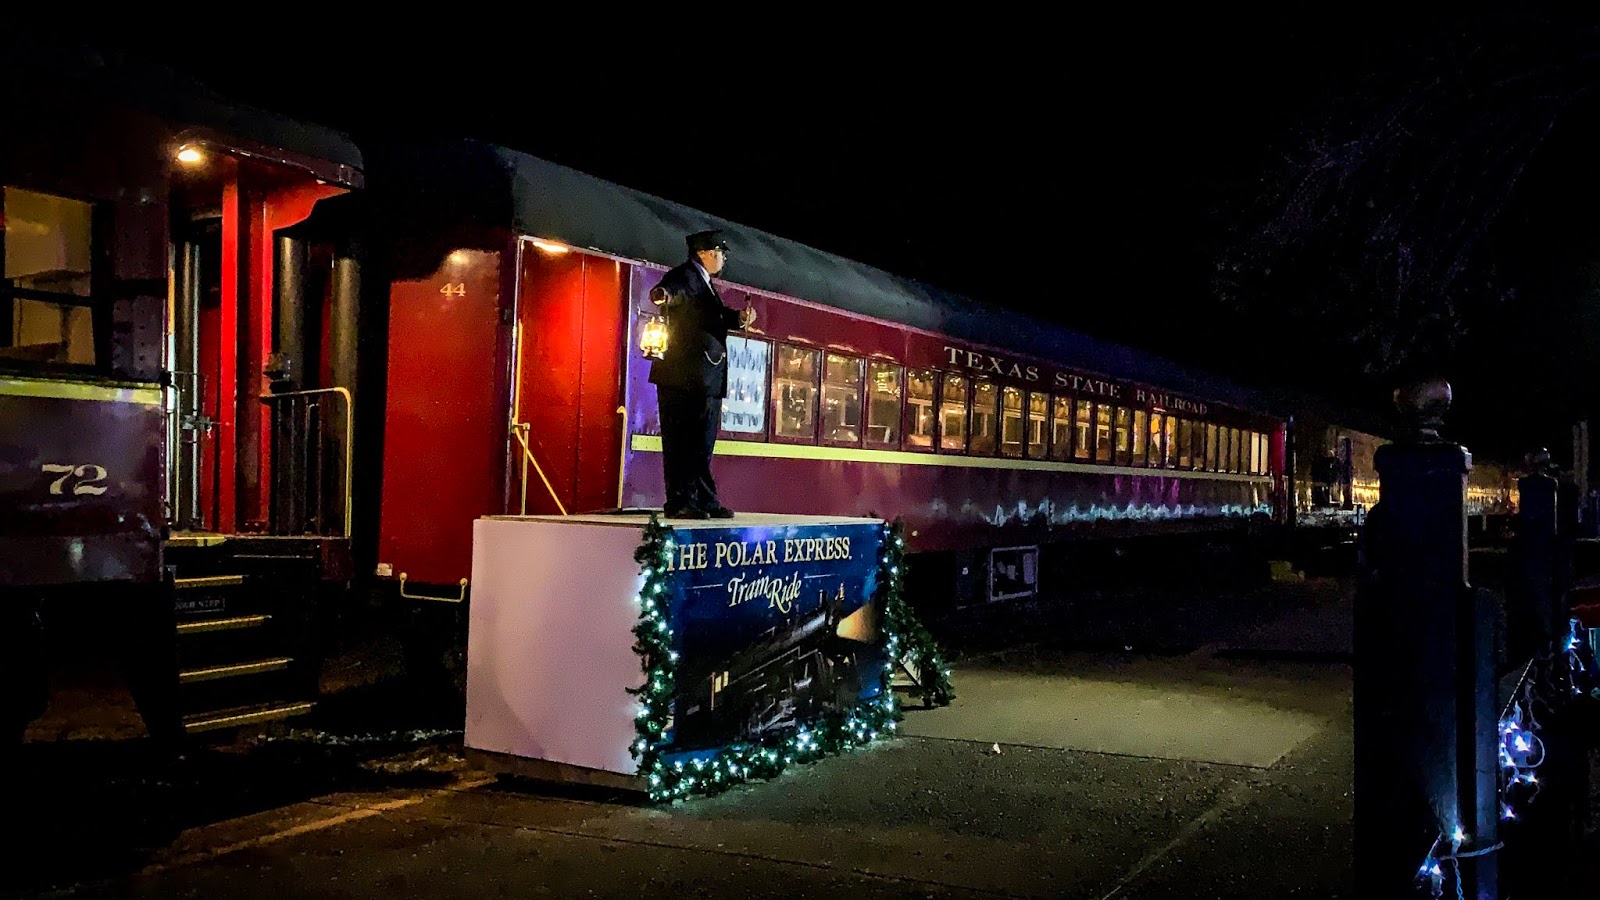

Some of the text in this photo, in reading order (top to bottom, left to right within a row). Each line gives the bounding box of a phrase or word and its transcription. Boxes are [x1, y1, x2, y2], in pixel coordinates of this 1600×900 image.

[439, 282, 466, 297] 44
[943, 345, 1208, 416] TEXAS STATE RAILROAD
[41, 463, 108, 496] 72
[665, 543, 708, 571] THE
[715, 541, 778, 567] POLAR
[728, 569, 802, 613] Train Ride
